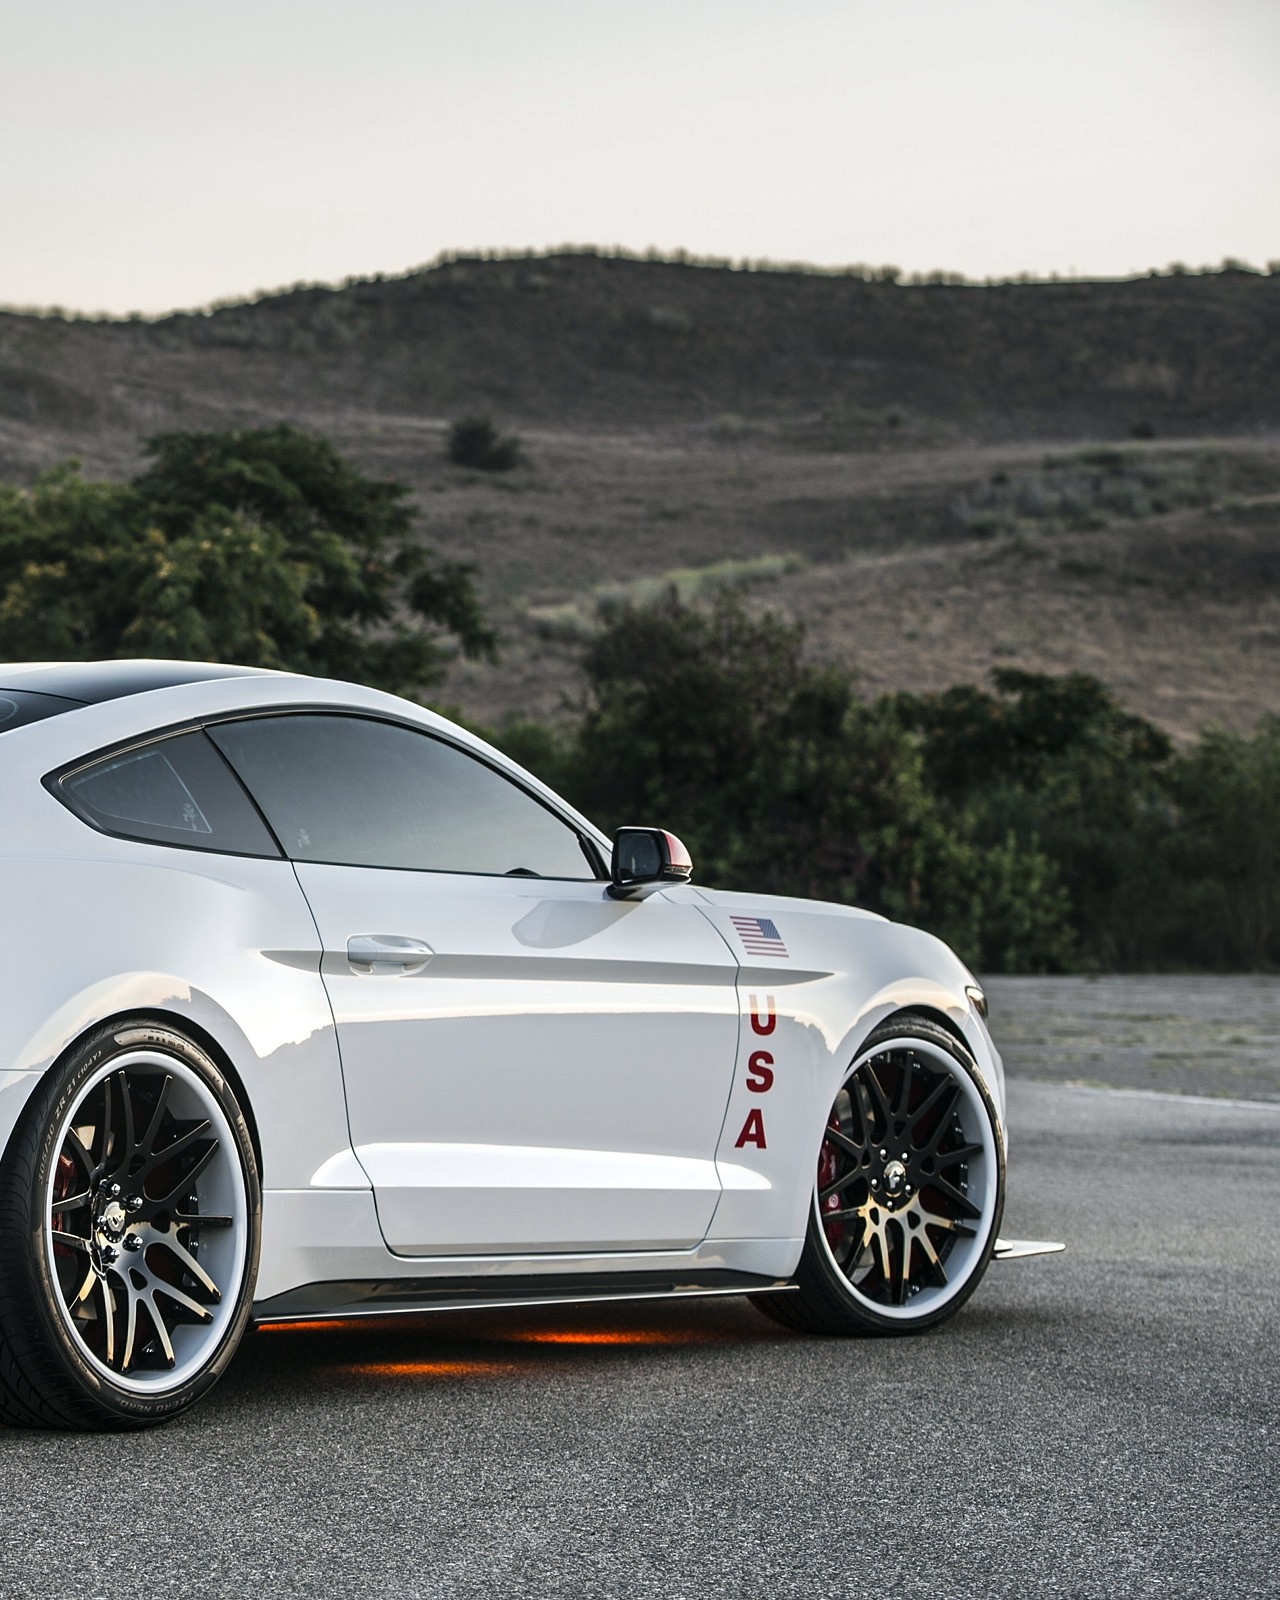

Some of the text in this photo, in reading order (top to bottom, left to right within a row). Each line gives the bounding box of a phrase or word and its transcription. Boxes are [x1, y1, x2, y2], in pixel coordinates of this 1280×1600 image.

[734, 993, 777, 1150] USA
[37, 1124, 55, 1185] 305/30
[54, 1099, 67, 1121] ZR
[66, 1077, 77, 1097] 21
[119, 1399, 152, 1413] NERO
